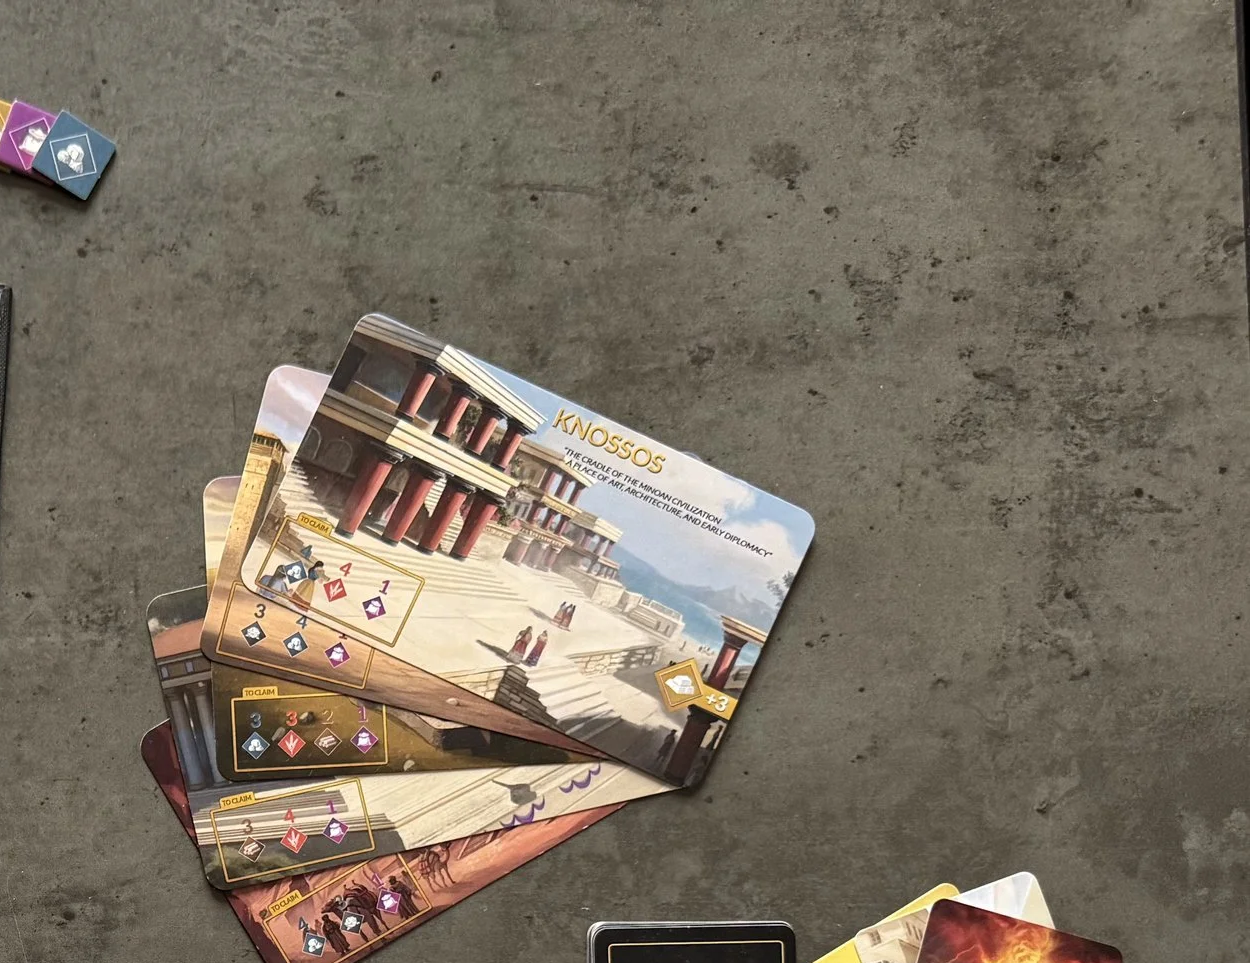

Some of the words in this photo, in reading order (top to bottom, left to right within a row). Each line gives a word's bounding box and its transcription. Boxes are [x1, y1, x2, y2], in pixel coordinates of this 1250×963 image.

[552, 407, 667, 475] KNOSSOS
[565, 459, 573, 468] A
[571, 461, 598, 479] PLACE
[595, 472, 609, 484] OF
[607, 477, 625, 491] ART,
[623, 485, 684, 518] ARCHITECTURE,
[683, 512, 702, 526] AND
[700, 520, 726, 537] EARLY
[580, 455, 612, 475] CRADLE
[612, 469, 623, 480] OF
[622, 474, 639, 487] THE
[637, 481, 672, 502] MINOAN
[670, 496, 722, 525] CIVILIZATION
[299, 515, 310, 524] TO
[308, 519, 329, 533] CLAIM
[339, 562, 353, 577] 4
[379, 579, 391, 596] 1
[254, 603, 267, 619] 3
[244, 689, 257, 697] TO
[257, 688, 275, 696] CLAIM
[706, 693, 729, 712] +3
[250, 711, 262, 728] 3
[285, 710, 298, 727] 3
[321, 709, 334, 725] 2
[357, 705, 369, 723] 1
[221, 798, 231, 806] TO
[230, 793, 252, 804] CLAIM
[325, 800, 337, 815] 1
[282, 808, 297, 825] 4
[241, 818, 255, 835] 3
[270, 903, 281, 912] TO
[278, 892, 299, 907] CLAIM
